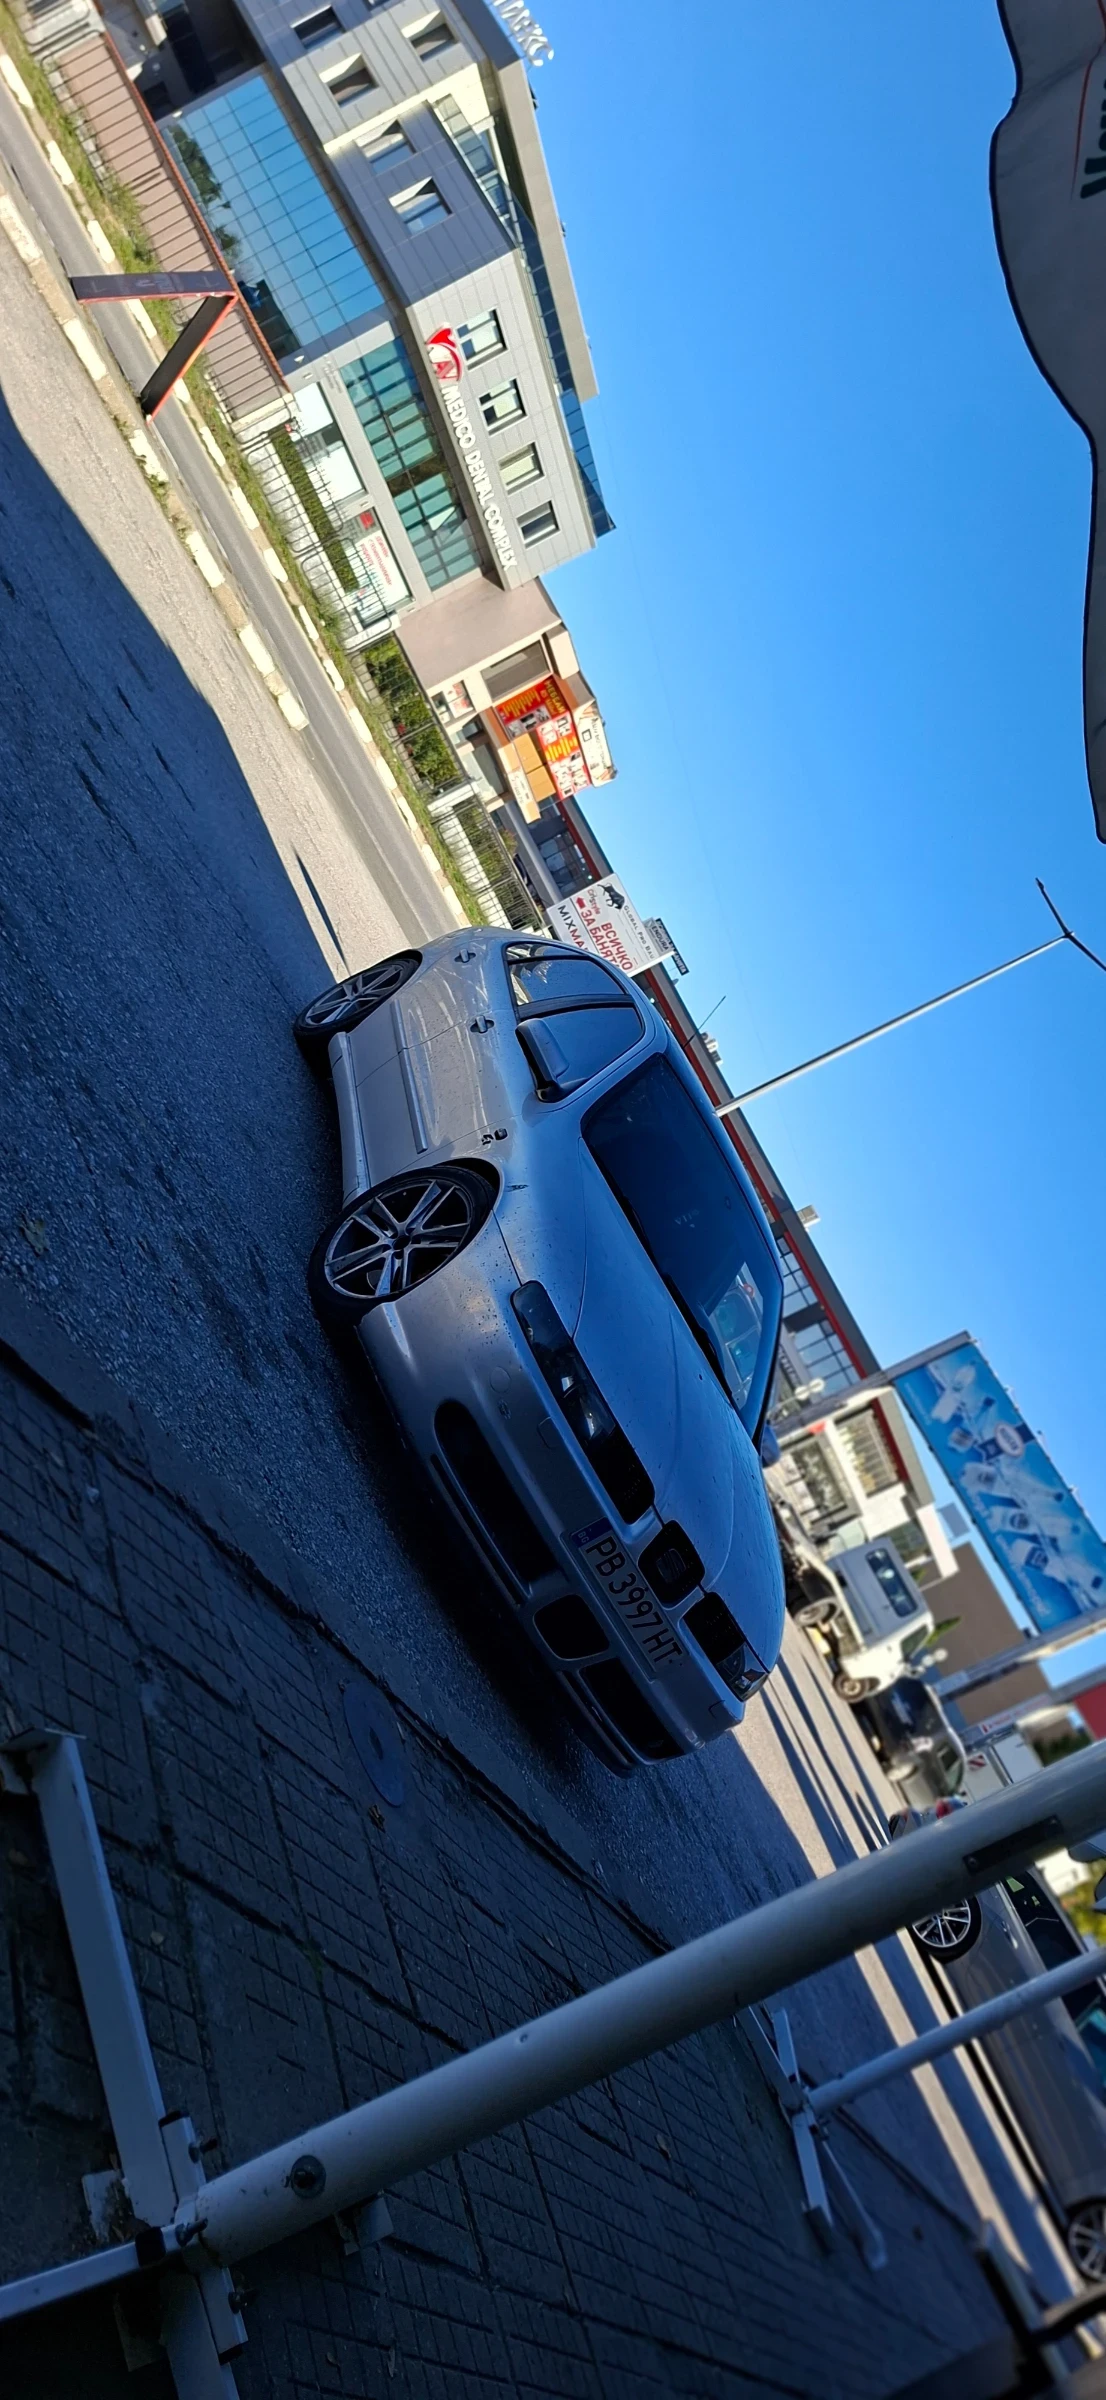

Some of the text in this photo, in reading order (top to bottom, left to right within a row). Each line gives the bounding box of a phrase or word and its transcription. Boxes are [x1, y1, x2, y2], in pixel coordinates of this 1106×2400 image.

[442, 384, 476, 449] MEDICO
[465, 450, 495, 506] DENTAL
[484, 503, 518, 571] COMPLEX
[557, 904, 588, 951] MIXMA
[581, 909, 620, 968] ЗА БАНЯТ
[601, 922, 633, 971] ВСИЧКО
[652, 926, 670, 951] ENDURA
[577, 1531, 589, 1543] BG
[585, 1535, 683, 1663] PB 3997 HT
